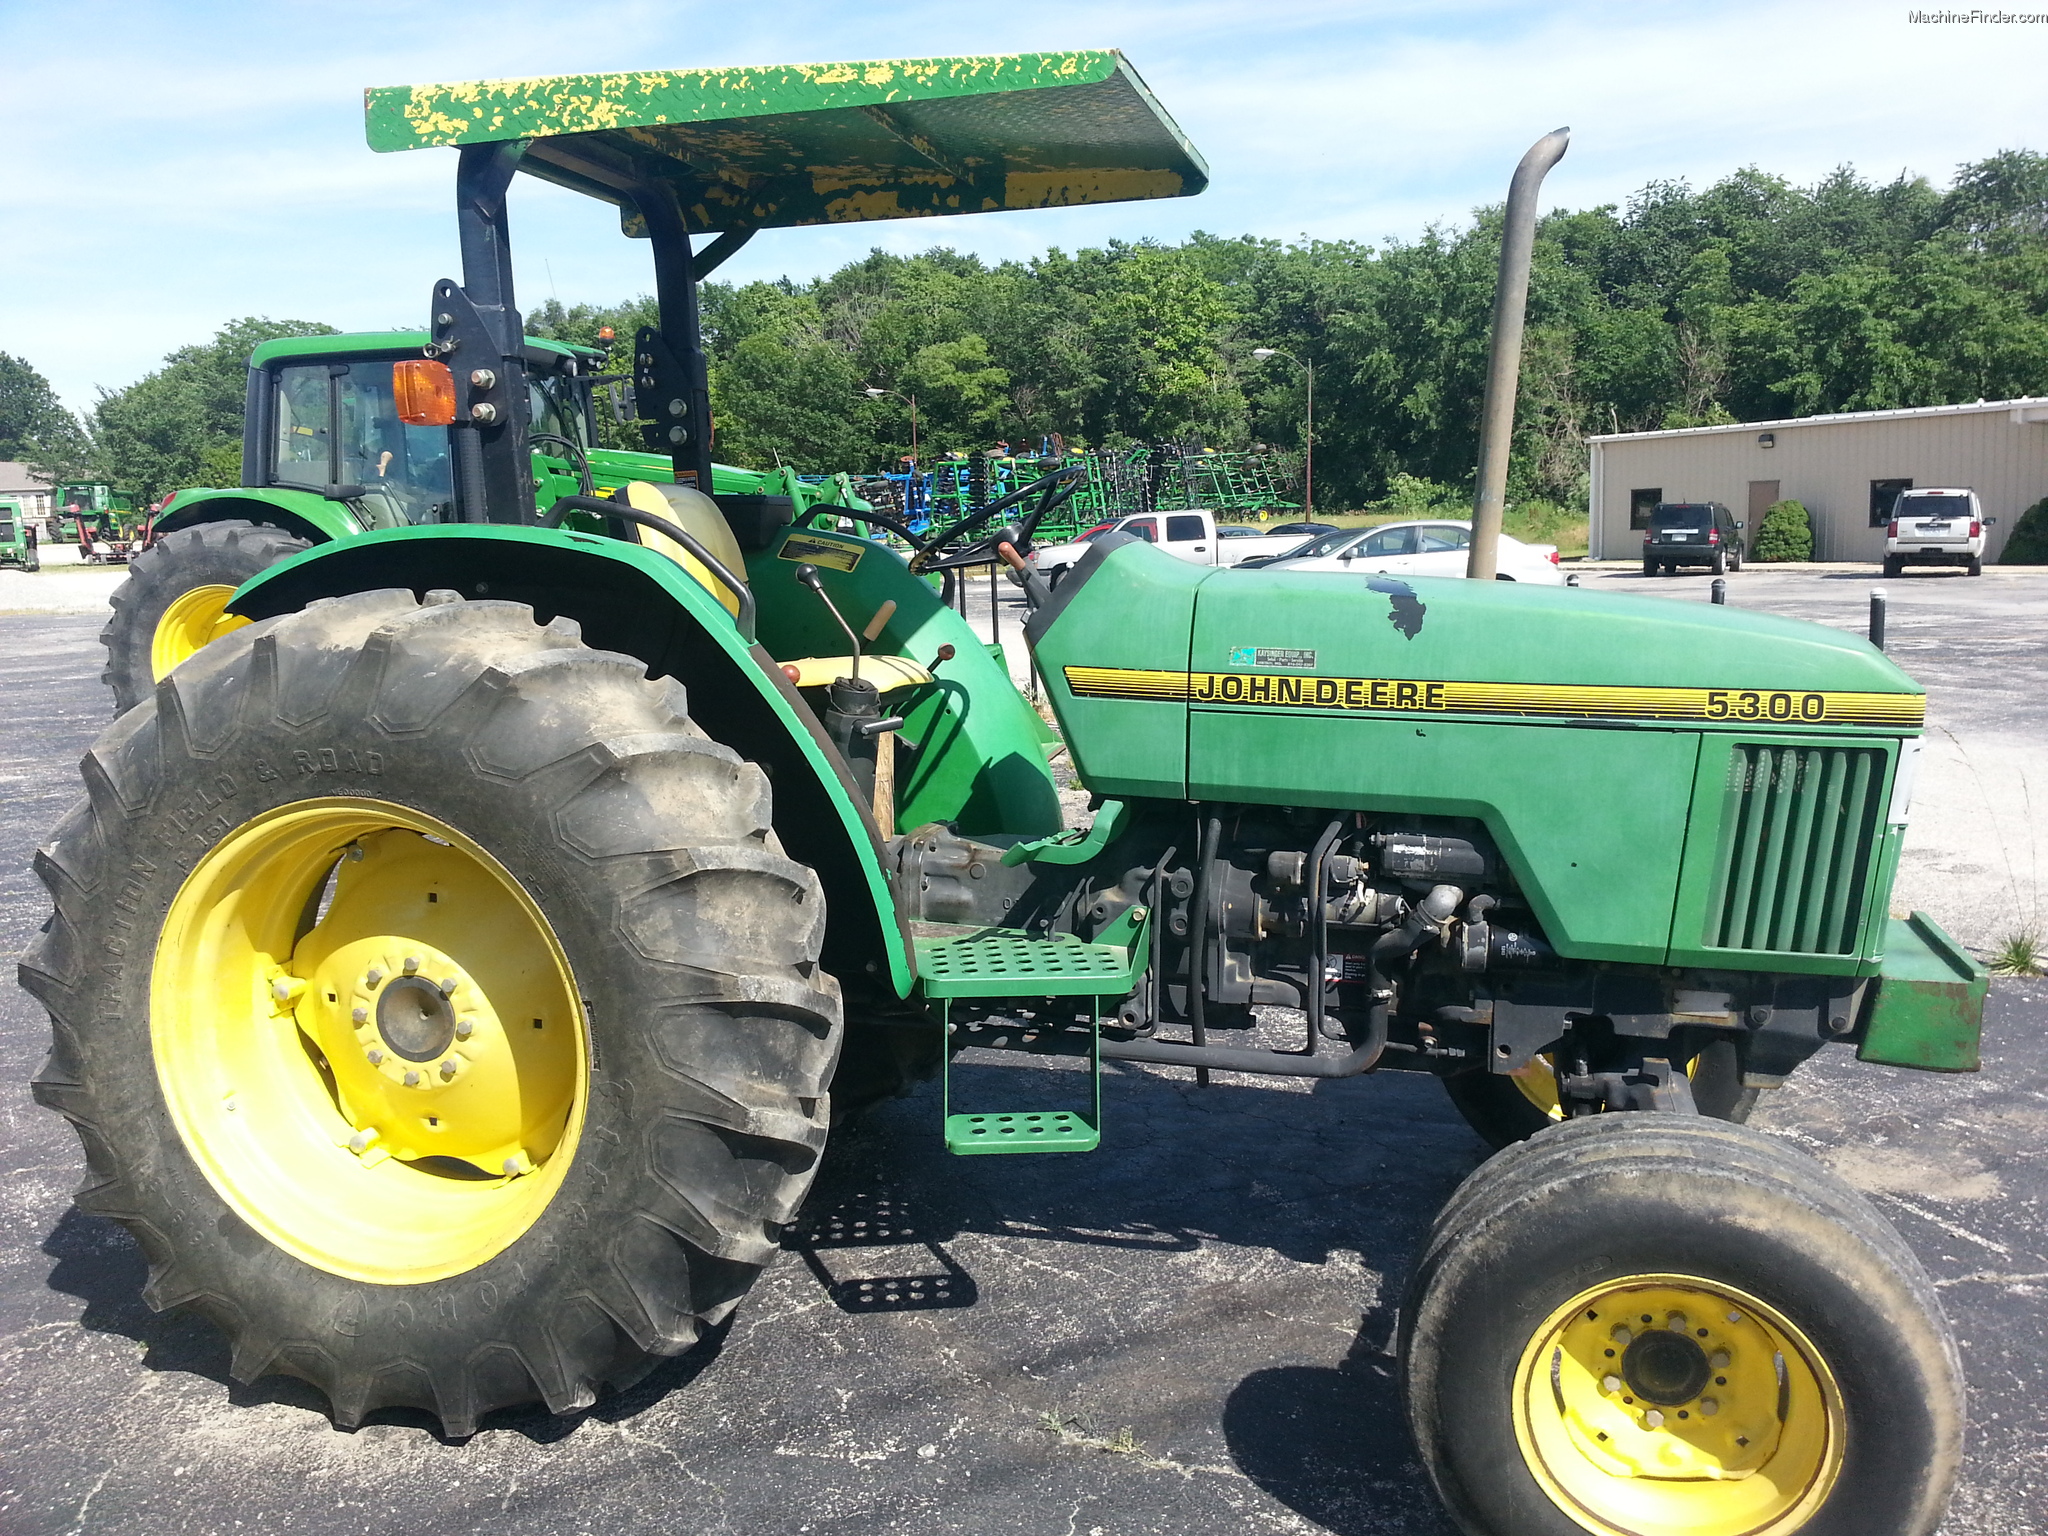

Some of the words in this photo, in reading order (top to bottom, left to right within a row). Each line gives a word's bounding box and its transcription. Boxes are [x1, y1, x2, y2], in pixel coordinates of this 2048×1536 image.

[817, 540, 845, 549] CAUTION
[1198, 675, 1302, 705] JOHN
[1316, 679, 1446, 709] DEERE
[1706, 691, 1825, 720] 5300
[154, 772, 238, 849] FIELD
[253, 758, 279, 783] &
[292, 748, 385, 776] ROAD
